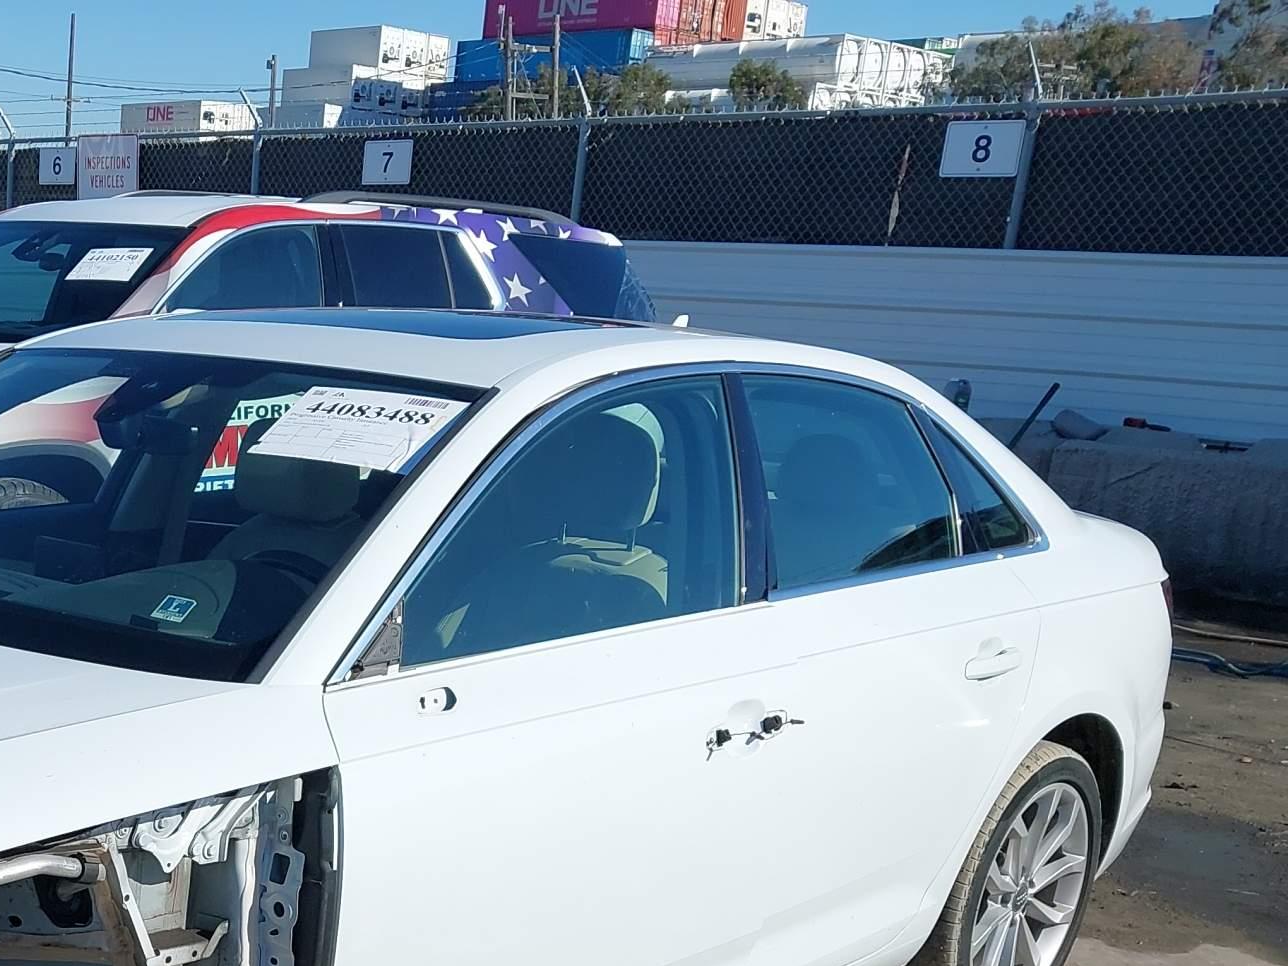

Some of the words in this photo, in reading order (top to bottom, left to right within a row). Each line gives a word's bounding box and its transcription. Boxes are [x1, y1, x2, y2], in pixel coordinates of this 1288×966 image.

[147, 105, 174, 121] ONE
[972, 134, 992, 163] 8
[53, 156, 62, 175] 6
[84, 156, 131, 170] INSPECTIONS
[382, 151, 394, 173] 7
[90, 174, 125, 189] VEHICLES
[306, 401, 436, 426] 44083488
